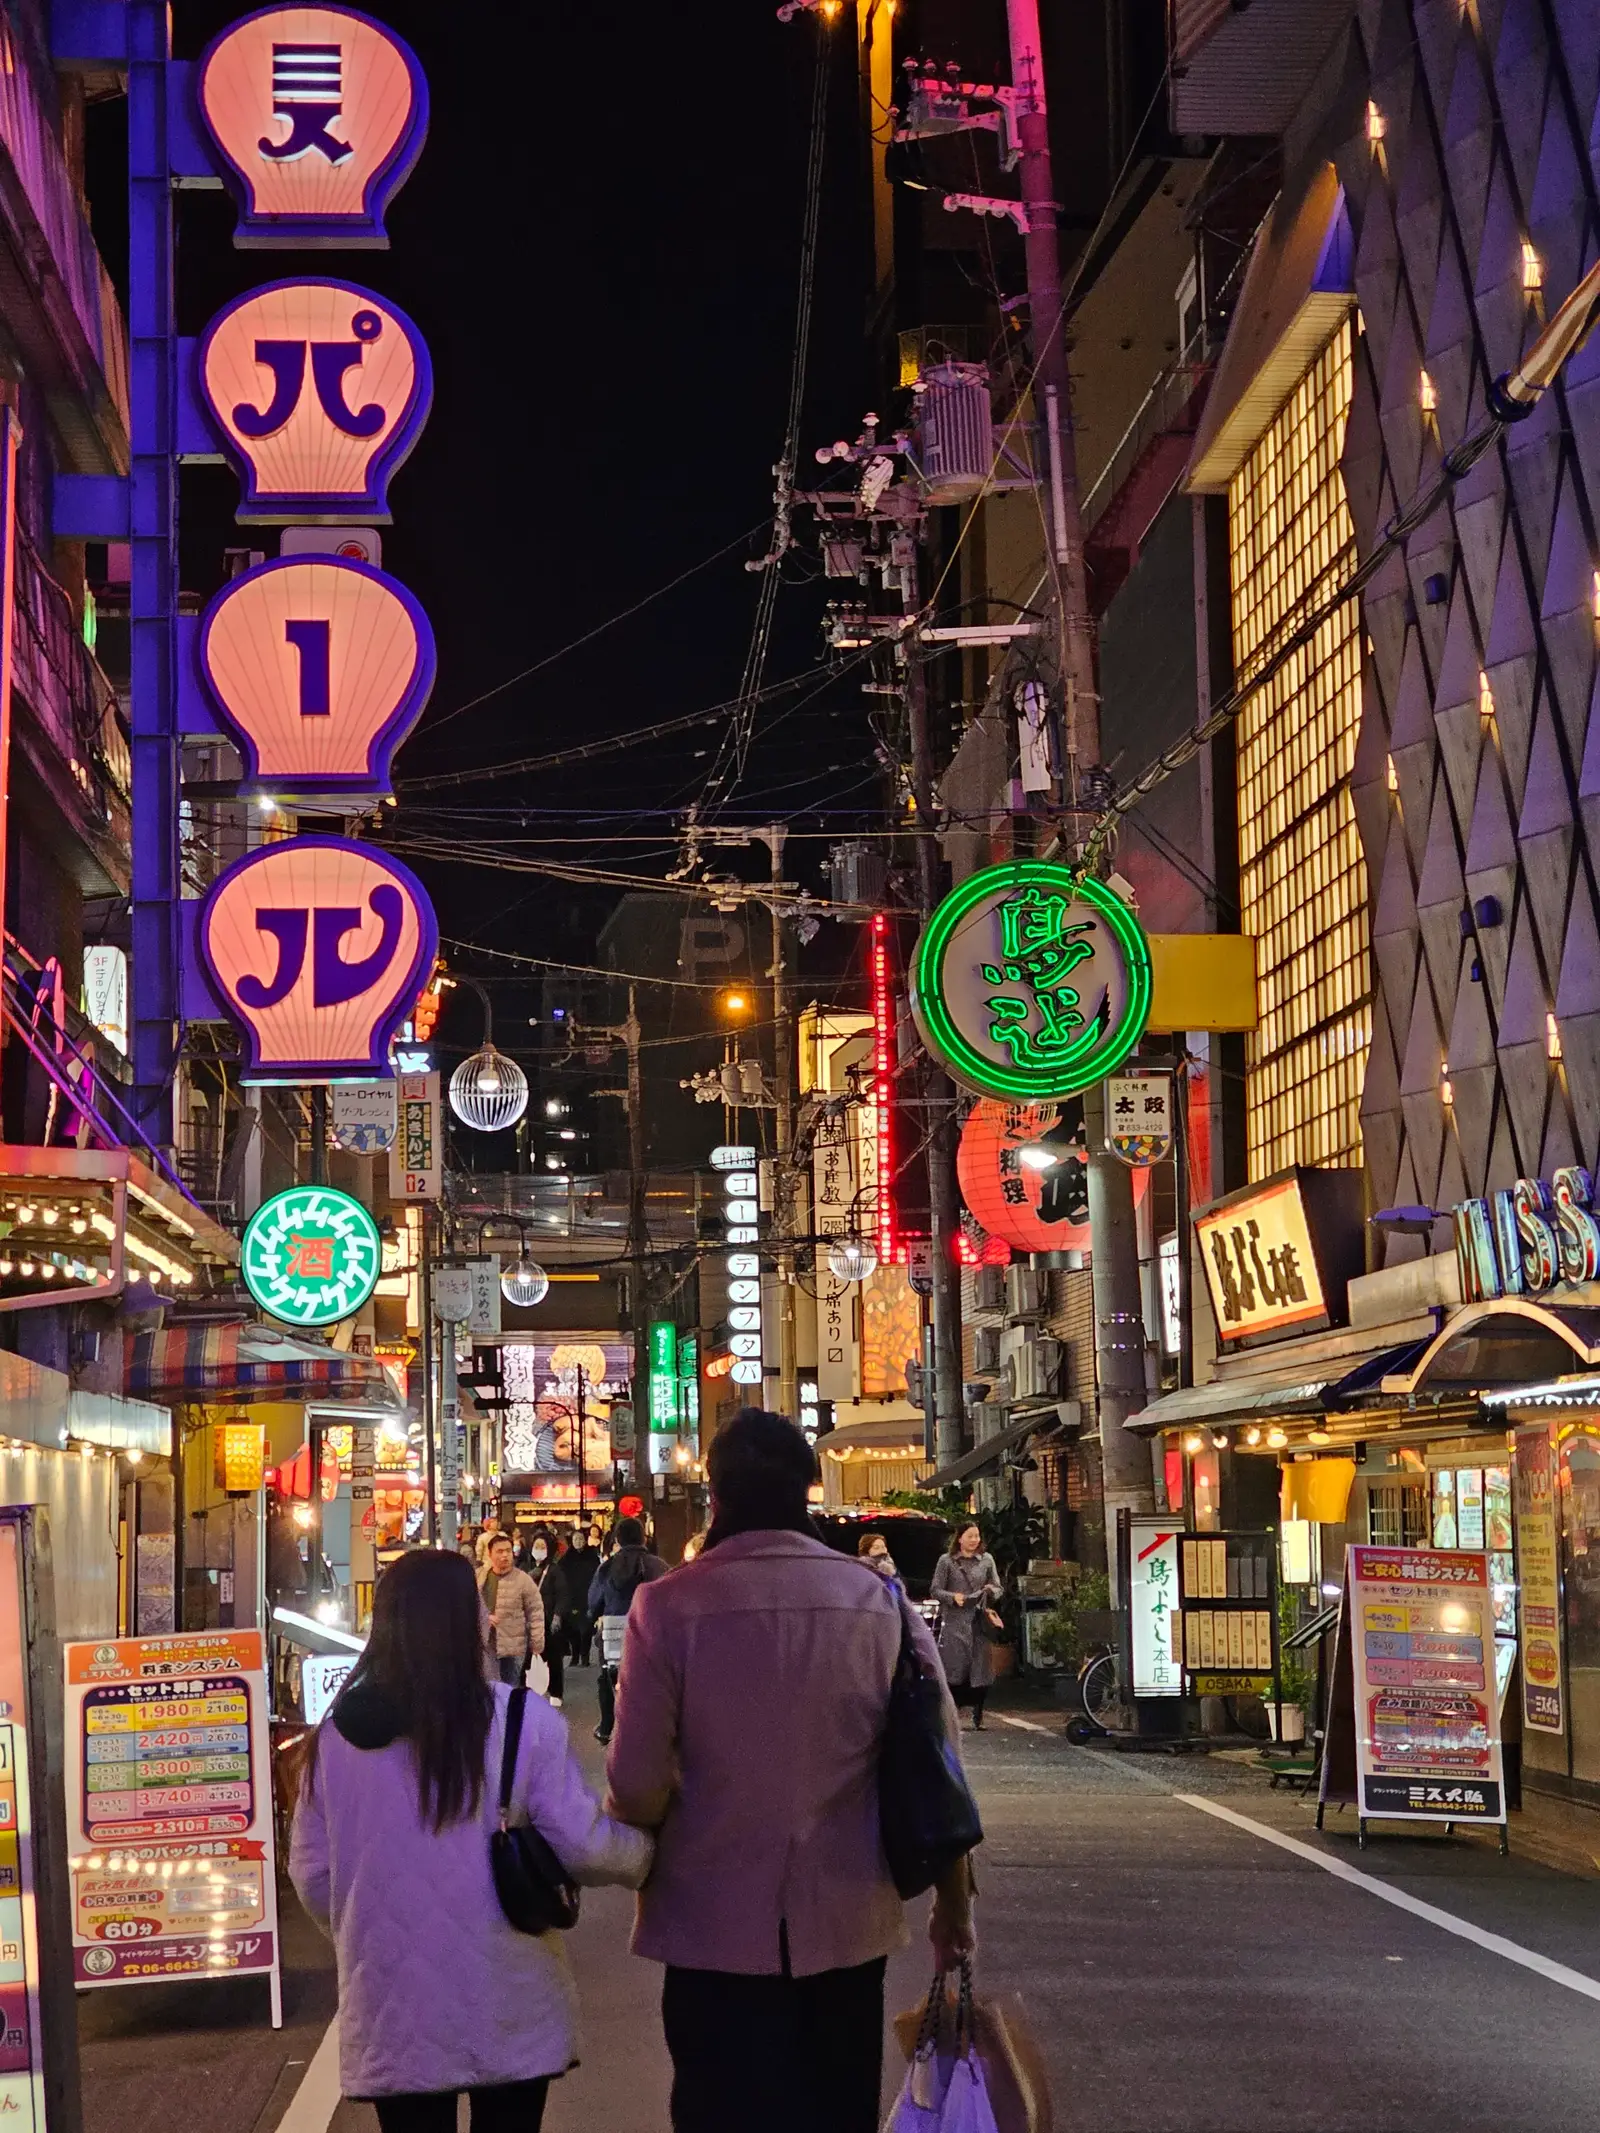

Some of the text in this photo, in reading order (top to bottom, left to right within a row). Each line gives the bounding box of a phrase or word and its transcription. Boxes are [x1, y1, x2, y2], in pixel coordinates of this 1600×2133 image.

[337, 1090, 394, 1100] ニューロイヤル
[407, 1104, 424, 1170] あきんど
[417, 1178, 426, 1192] 2
[1452, 1166, 1600, 1304] MISS
[285, 1232, 336, 1281] 酒
[476, 1273, 490, 1322] かなめや
[1362, 1562, 1480, 1582] ご安心料金システム
[140, 1658, 241, 1676] 料金システム
[127, 1680, 206, 1697] セット料金
[1206, 1676, 1254, 1691] OSAKA
[1408, 1786, 1485, 1804] ミス大阪
[1409, 1800, 1425, 1809] TEL
[104, 1920, 154, 1938] 60分
